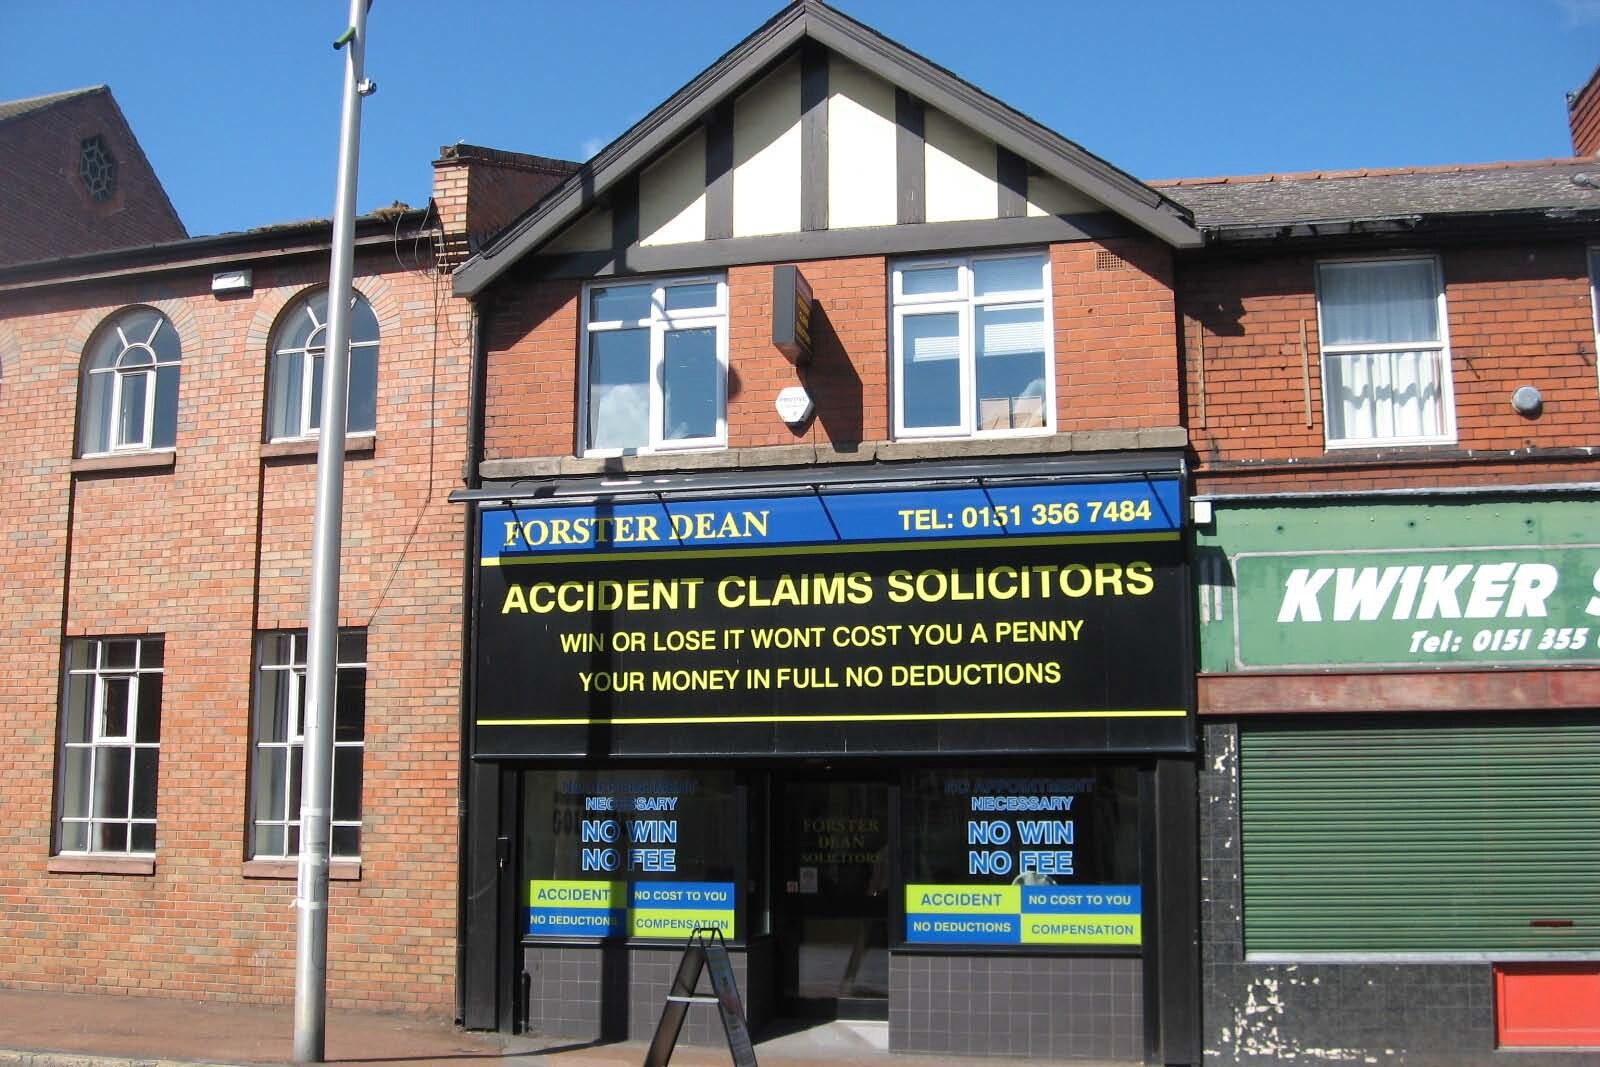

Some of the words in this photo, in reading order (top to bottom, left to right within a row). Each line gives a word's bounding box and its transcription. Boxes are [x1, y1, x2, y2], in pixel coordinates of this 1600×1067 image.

[898, 508, 953, 531] TEL:
[961, 505, 1021, 529] 0151
[1031, 502, 1080, 525] 356
[1087, 499, 1152, 523] 7484
[503, 516, 659, 546] FORSTER
[669, 511, 770, 540] DEAN
[501, 577, 704, 614] ACCIDENT
[716, 572, 874, 608] CLAIMS
[887, 561, 1155, 604] SOLICITORS
[1276, 562, 1559, 623] KWIKER
[560, 632, 604, 653] WIN
[612, 631, 647, 652] OR
[652, 629, 716, 652] LOSE
[723, 628, 745, 650] IT
[750, 626, 827, 649] WONT
[832, 624, 902, 648] COST
[908, 623, 963, 646] YOU
[969, 623, 989, 644] A
[995, 619, 1085, 644] PENNY
[1408, 629, 1463, 653] Tel:
[1472, 627, 1533, 652] 0151
[1537, 626, 1589, 650] 355
[578, 671, 646, 693] YOUR
[651, 668, 741, 692] MONEY
[746, 668, 771, 690] IN
[776, 666, 839, 689] FULL
[845, 664, 884, 688] NO
[891, 661, 1062, 687] DEDUCTIONS
[585, 796, 678, 811] NECSARY
[971, 796, 1074, 811] NECESSARY
[582, 820, 619, 843] NO
[626, 820, 677, 843] WIN
[968, 820, 1011, 845] NO
[1016, 820, 1074, 845] WIN
[582, 848, 619, 872] NO
[628, 848, 676, 872] FEE
[968, 850, 1012, 875] NO
[1019, 850, 1073, 875] FEE
[537, 888, 613, 901] ACCIDENT
[635, 890, 651, 901] NO
[653, 890, 683, 901] COST
[686, 891, 701, 902] TO
[704, 891, 727, 901] YOU
[921, 893, 1002, 906] ACCIDENT
[1028, 894, 1047, 905] NO
[1050, 895, 1082, 905] COST
[1085, 895, 1103, 905] TO
[1105, 895, 1131, 906] YOU
[530, 915, 546, 925] NO
[636, 918, 729, 930] COMPENSATION
[913, 921, 931, 932] NO
[934, 921, 1012, 933] DEDUCTIONS
[1031, 924, 1134, 936] COMPENSATION
